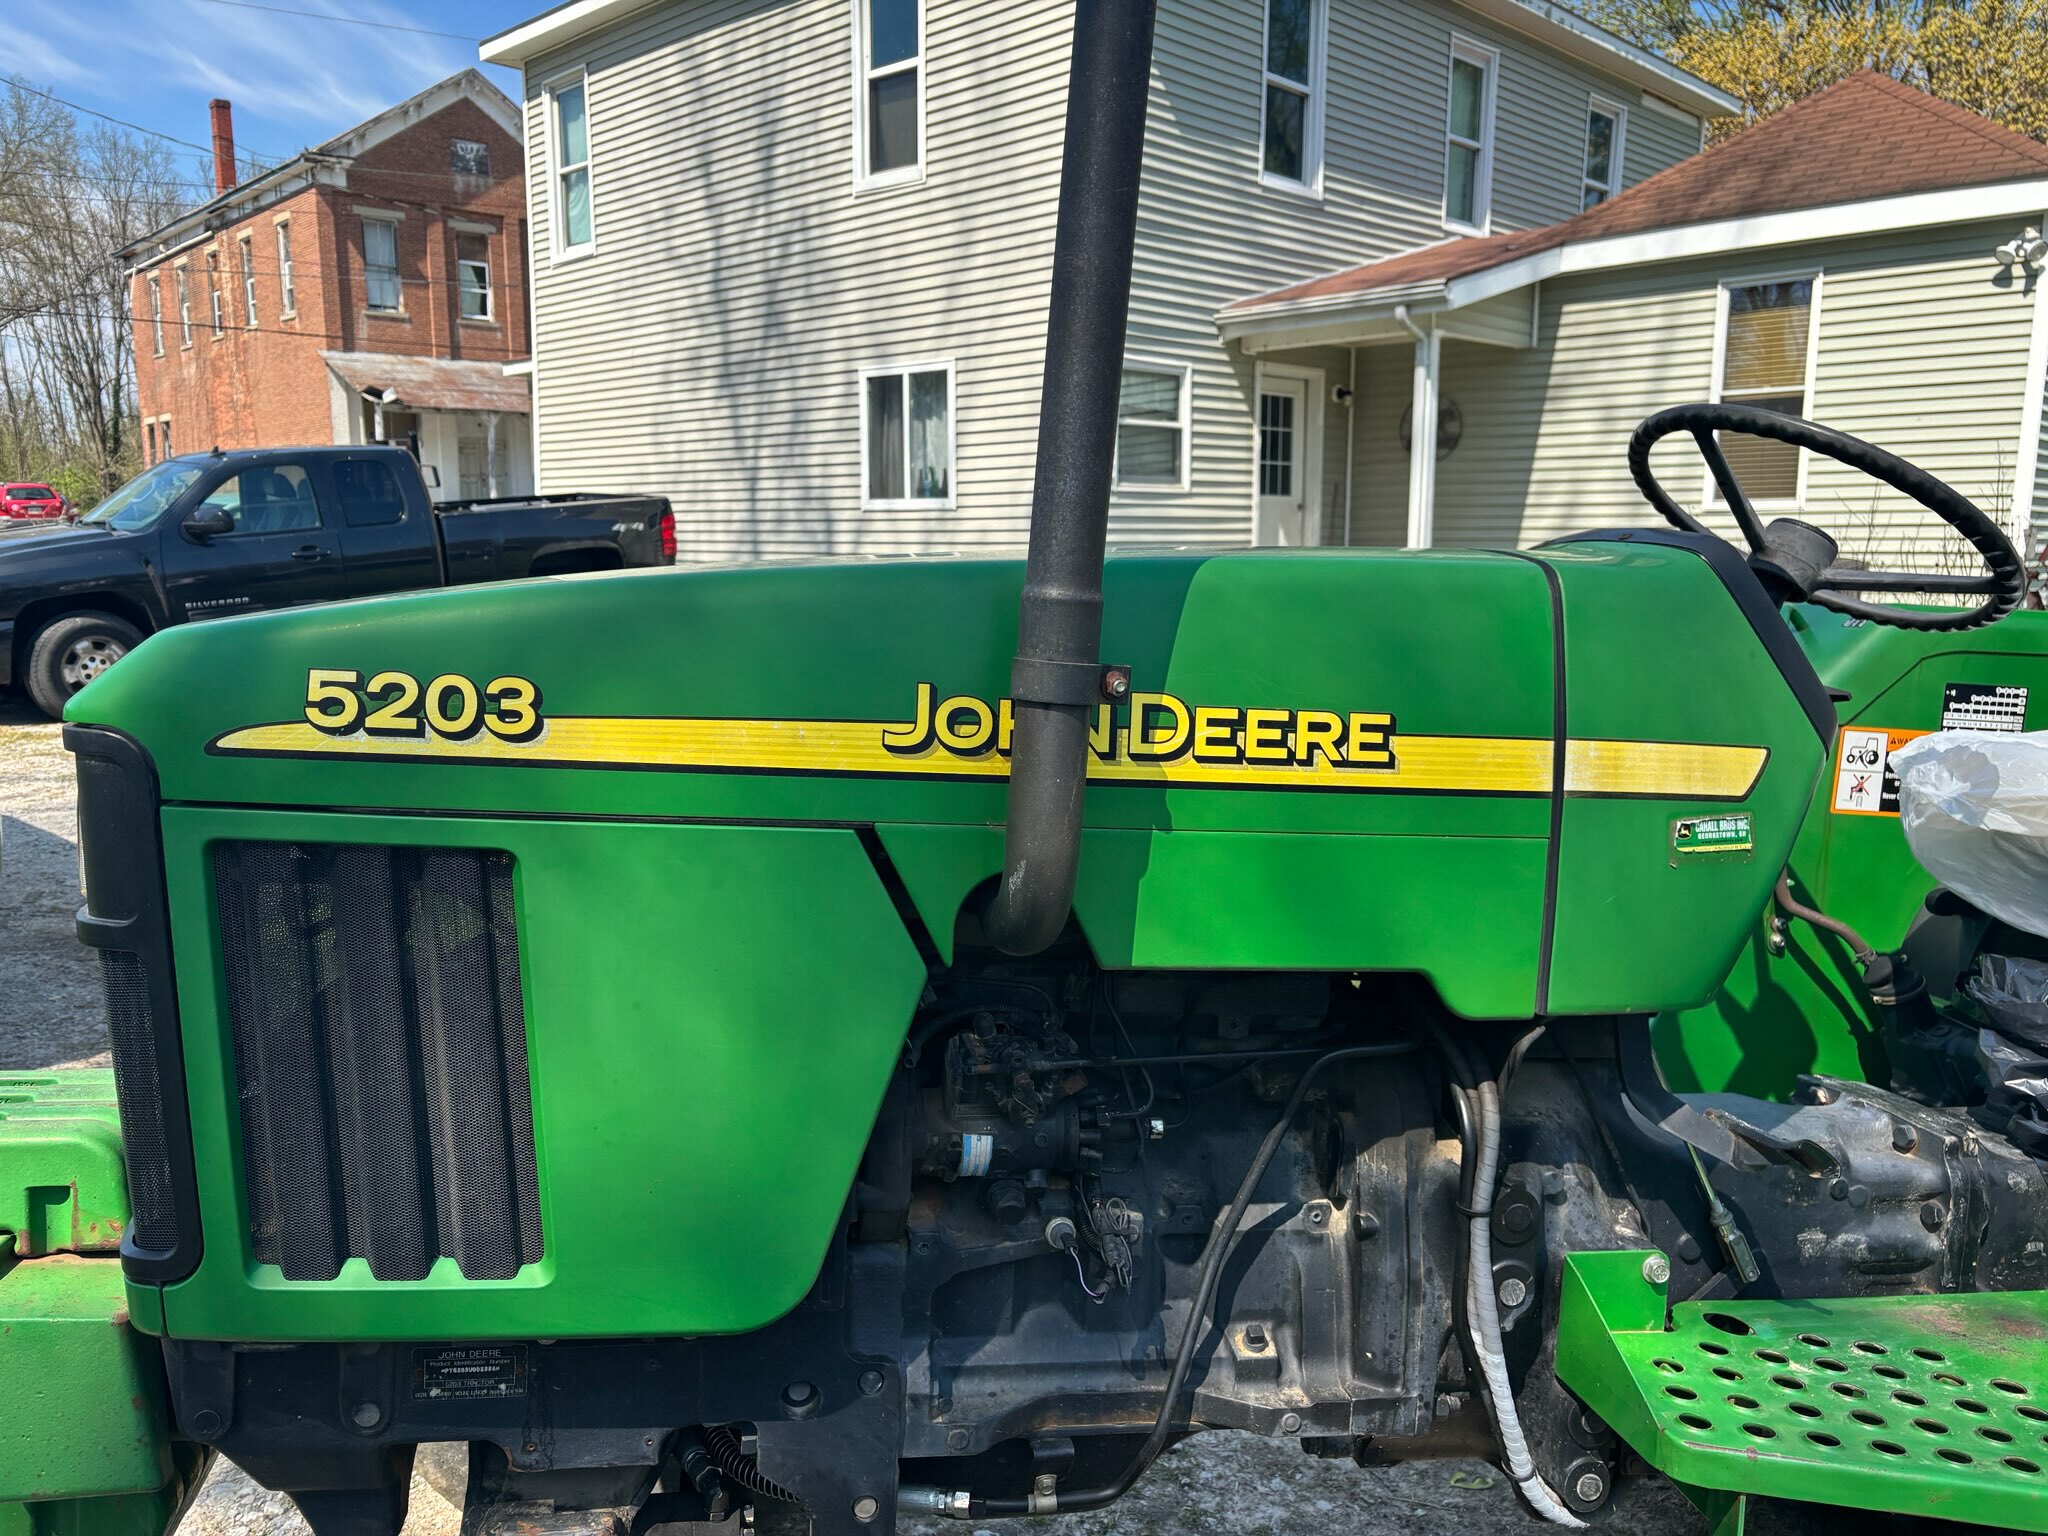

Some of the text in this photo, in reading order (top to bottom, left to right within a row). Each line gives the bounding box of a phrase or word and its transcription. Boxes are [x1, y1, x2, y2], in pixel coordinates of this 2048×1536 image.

[185, 597, 249, 609] SILVERADO
[304, 668, 544, 743] 5203
[1128, 692, 1397, 769] DEERE
[1720, 819, 1736, 831] BROS
[438, 1349, 502, 1359] JOHN DEERE
